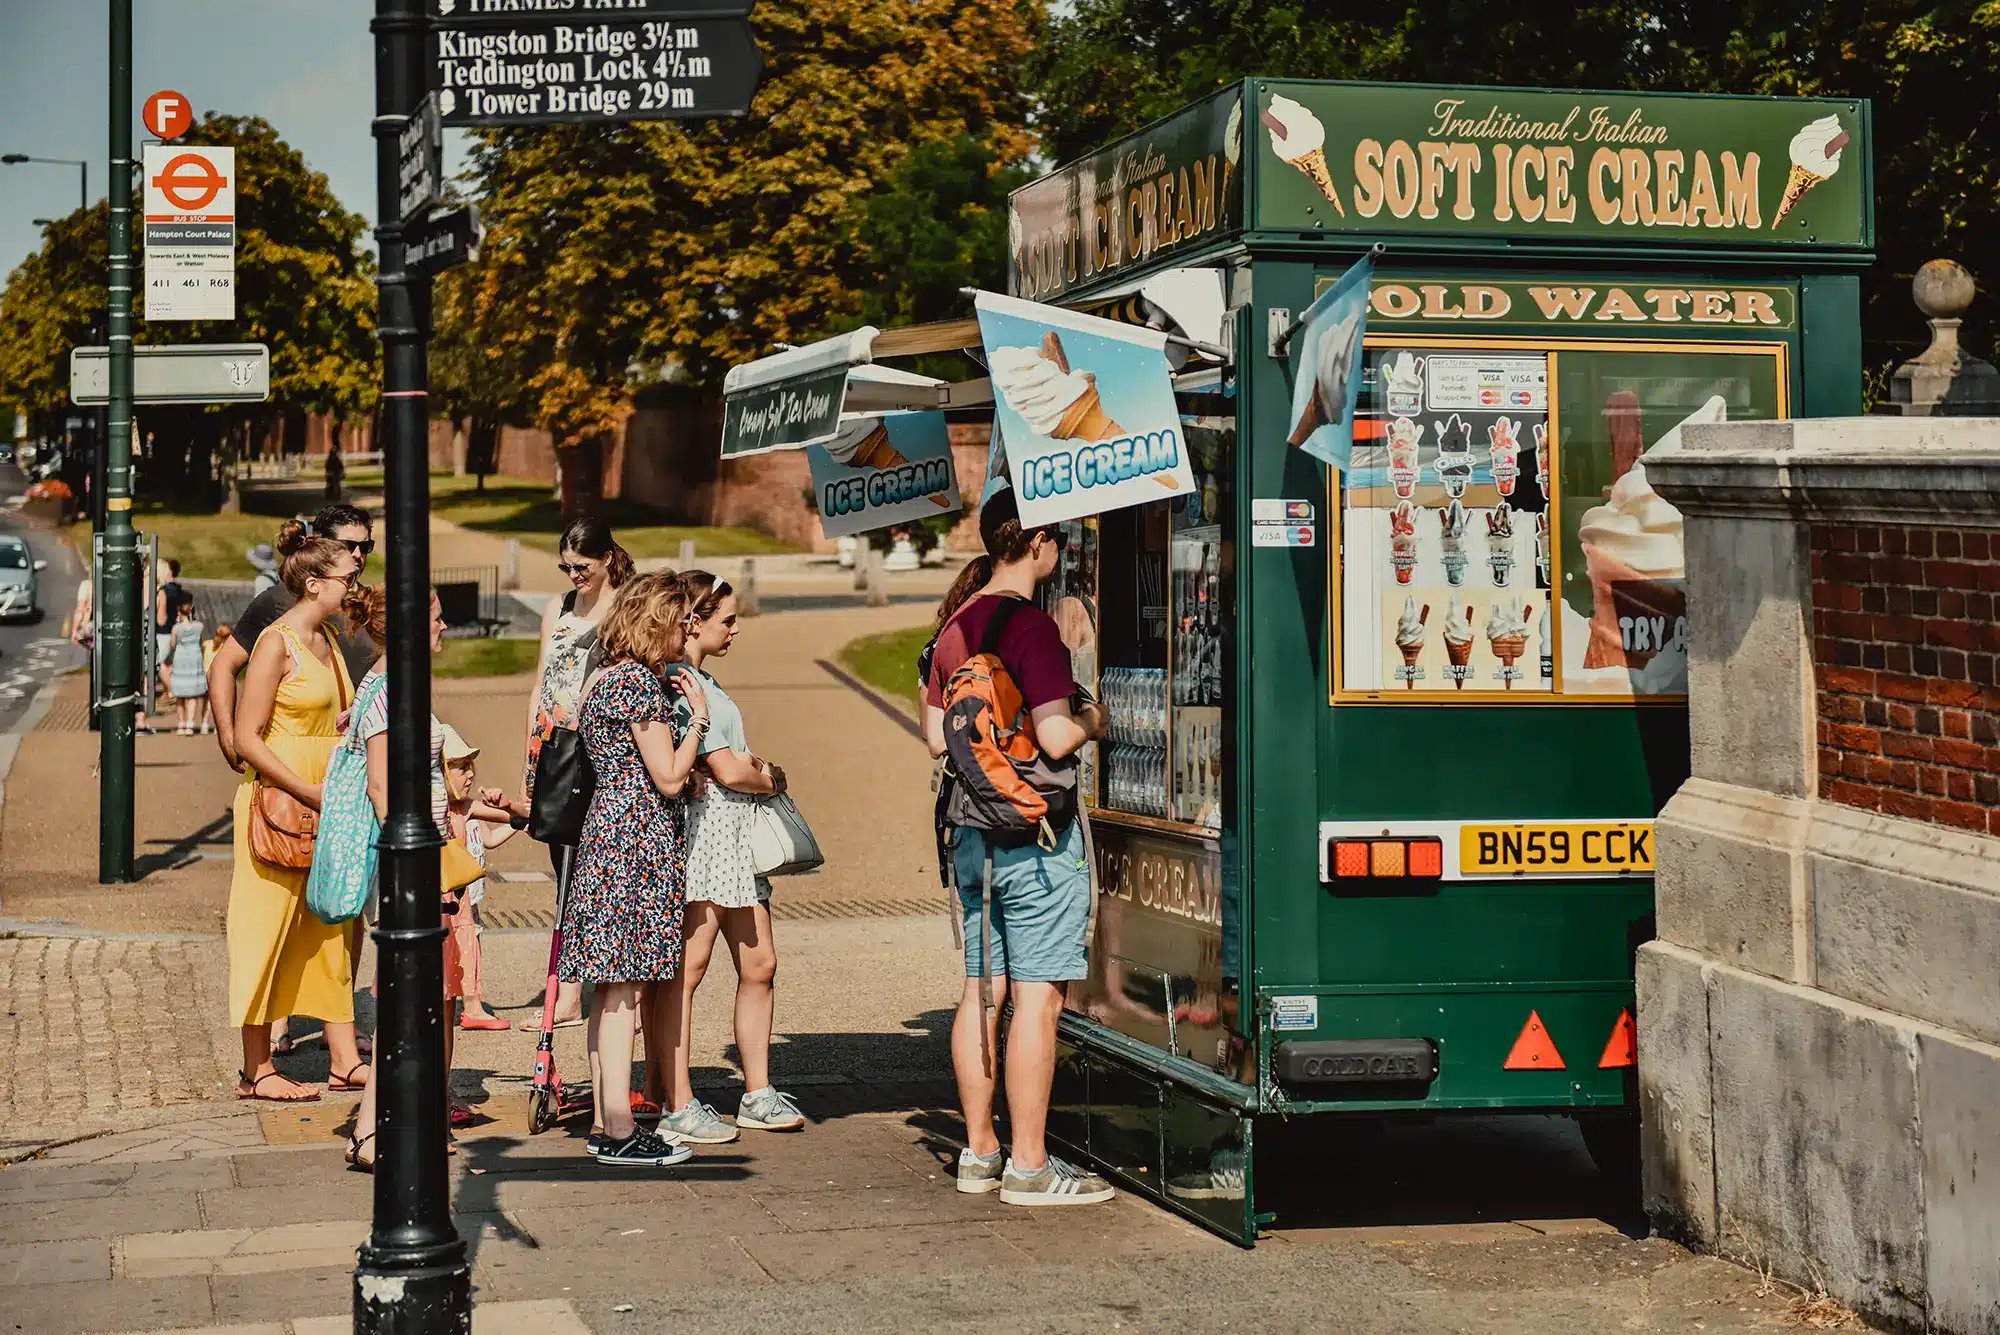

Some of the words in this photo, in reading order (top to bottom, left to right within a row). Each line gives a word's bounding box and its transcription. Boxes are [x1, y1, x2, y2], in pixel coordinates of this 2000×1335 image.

[437, 29, 548, 61] Kingston
[553, 24, 637, 57] Bridge
[437, 57, 576, 90] Teddington
[583, 52, 649, 82] Lock
[157, 99, 179, 133] F
[464, 88, 542, 116] Tower
[546, 84, 632, 116] Bridge
[1428, 98, 1571, 143] Traditional
[1571, 105, 1668, 146] Italian
[1059, 157, 1123, 215] Tradonal
[1120, 143, 1167, 189] Italian
[1353, 138, 1481, 221] SOFT
[1492, 142, 1576, 224] ICE
[1587, 147, 1763, 230] CREAM
[149, 230, 184, 239] Hampton
[185, 230, 206, 238] Court
[207, 230, 231, 238] Palace
[1028, 214, 1080, 298] SOFT
[1083, 196, 1122, 277] ICE
[1127, 153, 1217, 260] CREAM
[152, 279, 170, 288] 411
[182, 278, 200, 288] 461
[210, 278, 230, 288] R68
[1366, 285, 1512, 319] OLD
[1527, 287, 1782, 325] WATER
[1482, 374, 1501, 382] VISA
[1510, 374, 1532, 383] VISA
[1022, 450, 1072, 501] ICE
[1075, 429, 1179, 490] CREAM
[825, 476, 866, 518] ICE
[867, 458, 950, 507] CREAM
[1259, 532, 1281, 541] VISA
[1618, 615, 1666, 652] TRY
[1478, 830, 1571, 865] BN59
[1581, 829, 1650, 865] CCK
[1137, 852, 1222, 927] CREAM
[1303, 1056, 1420, 1077] COLDCAR
